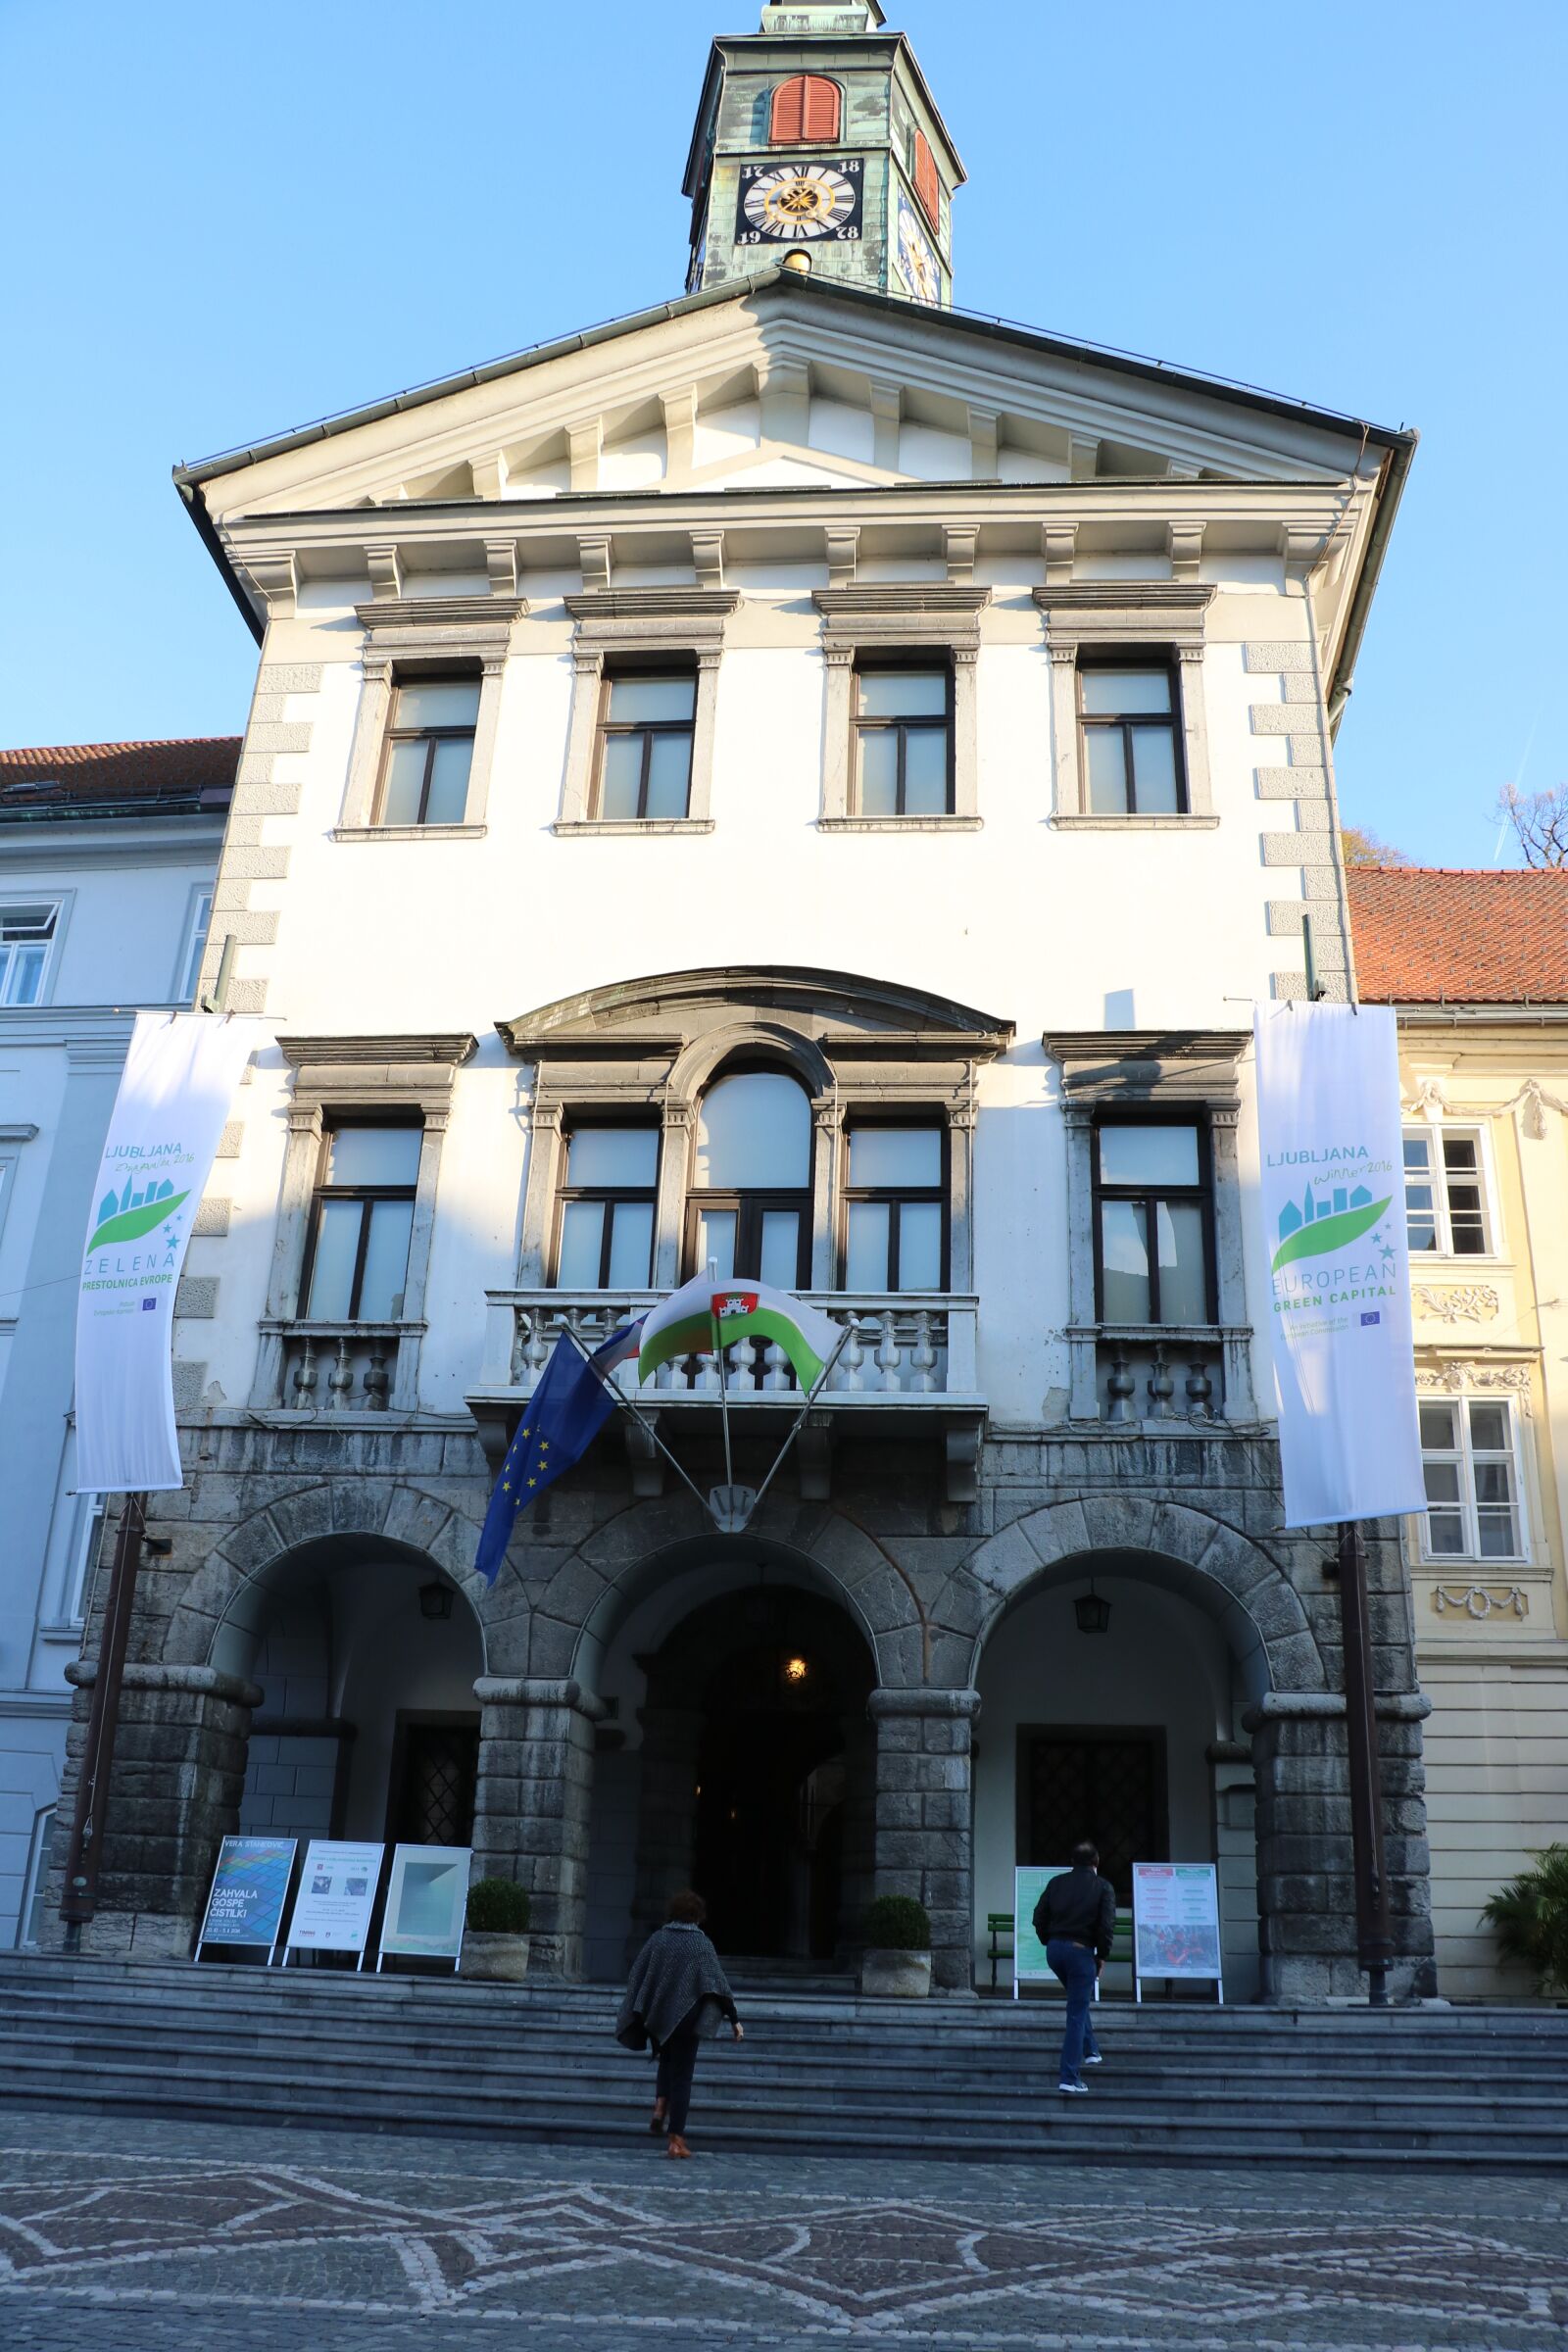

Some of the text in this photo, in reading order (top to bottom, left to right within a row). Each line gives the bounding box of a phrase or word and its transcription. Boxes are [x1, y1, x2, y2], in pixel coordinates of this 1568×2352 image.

[742, 166, 764, 179] 17
[838, 161, 860, 173] 18
[737, 230, 761, 245] 19
[835, 225, 859, 240] 78
[105, 1143, 182, 1159] LJUBLJANA
[173, 1152, 195, 1164] 2016
[1267, 1145, 1369, 1167] LJUBLJANA
[1367, 1160, 1394, 1173] 2016
[84, 1252, 174, 1275] ZELENA
[82, 1274, 173, 1291] PRESTOLNICA EVROPE
[1272, 1262, 1396, 1296] EUROPEAN
[1274, 1285, 1396, 1313] GREEN CAPITAL
[213, 1888, 258, 1898] ZAHVALA
[211, 1898, 245, 1907] GOSPE
[210, 1907, 247, 1918] ČISTILKI
